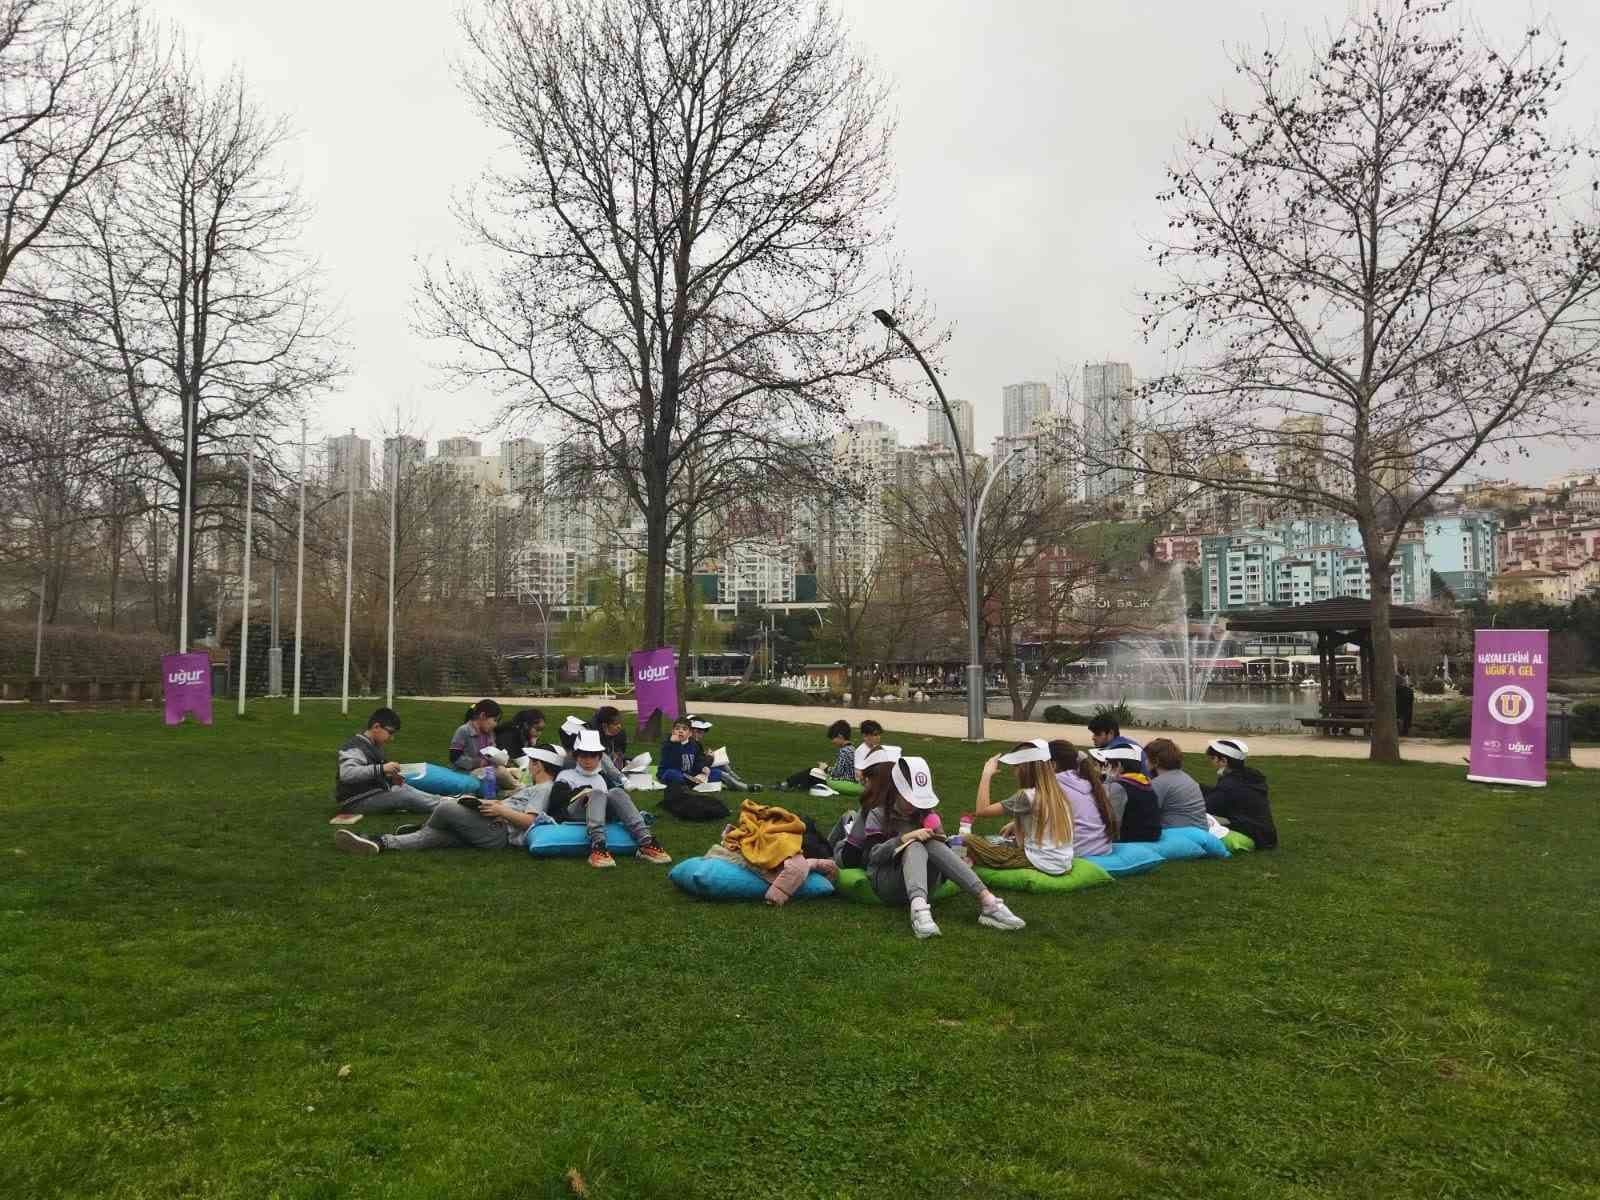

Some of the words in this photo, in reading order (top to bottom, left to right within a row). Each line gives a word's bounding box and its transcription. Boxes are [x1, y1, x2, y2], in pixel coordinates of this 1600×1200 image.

[1532, 653, 1544, 665] AL
[1519, 665, 1536, 676] GEL
[1501, 694, 1521, 716] U
